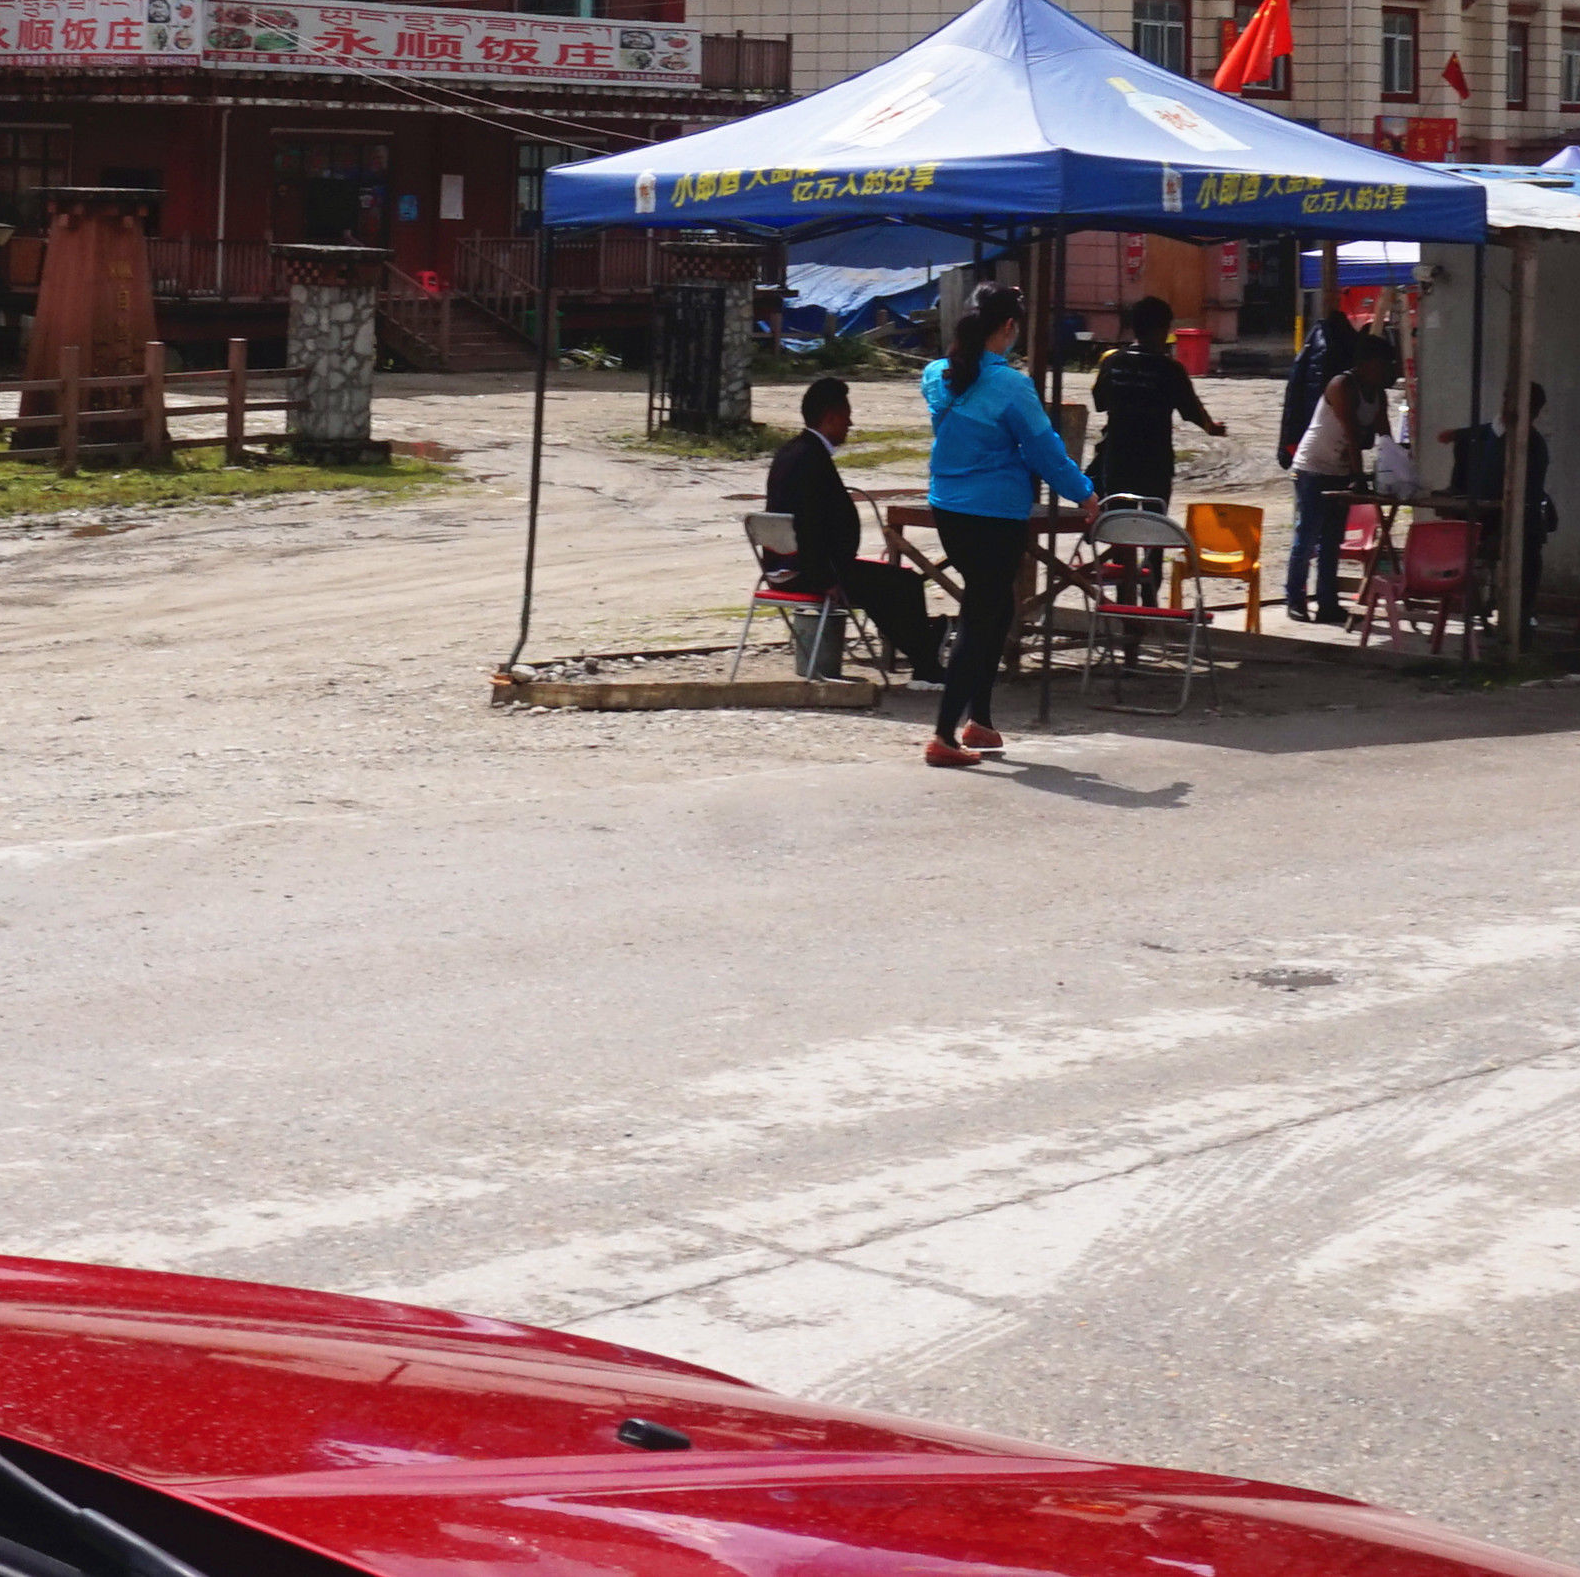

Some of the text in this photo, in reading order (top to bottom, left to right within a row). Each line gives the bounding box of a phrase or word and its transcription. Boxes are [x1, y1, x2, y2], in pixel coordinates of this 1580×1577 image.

[312, 26, 616, 68] 永顺饭庄
[792, 162, 944, 203] 亿万人的分享
[1301, 183, 1409, 214] 亿万人的分享
